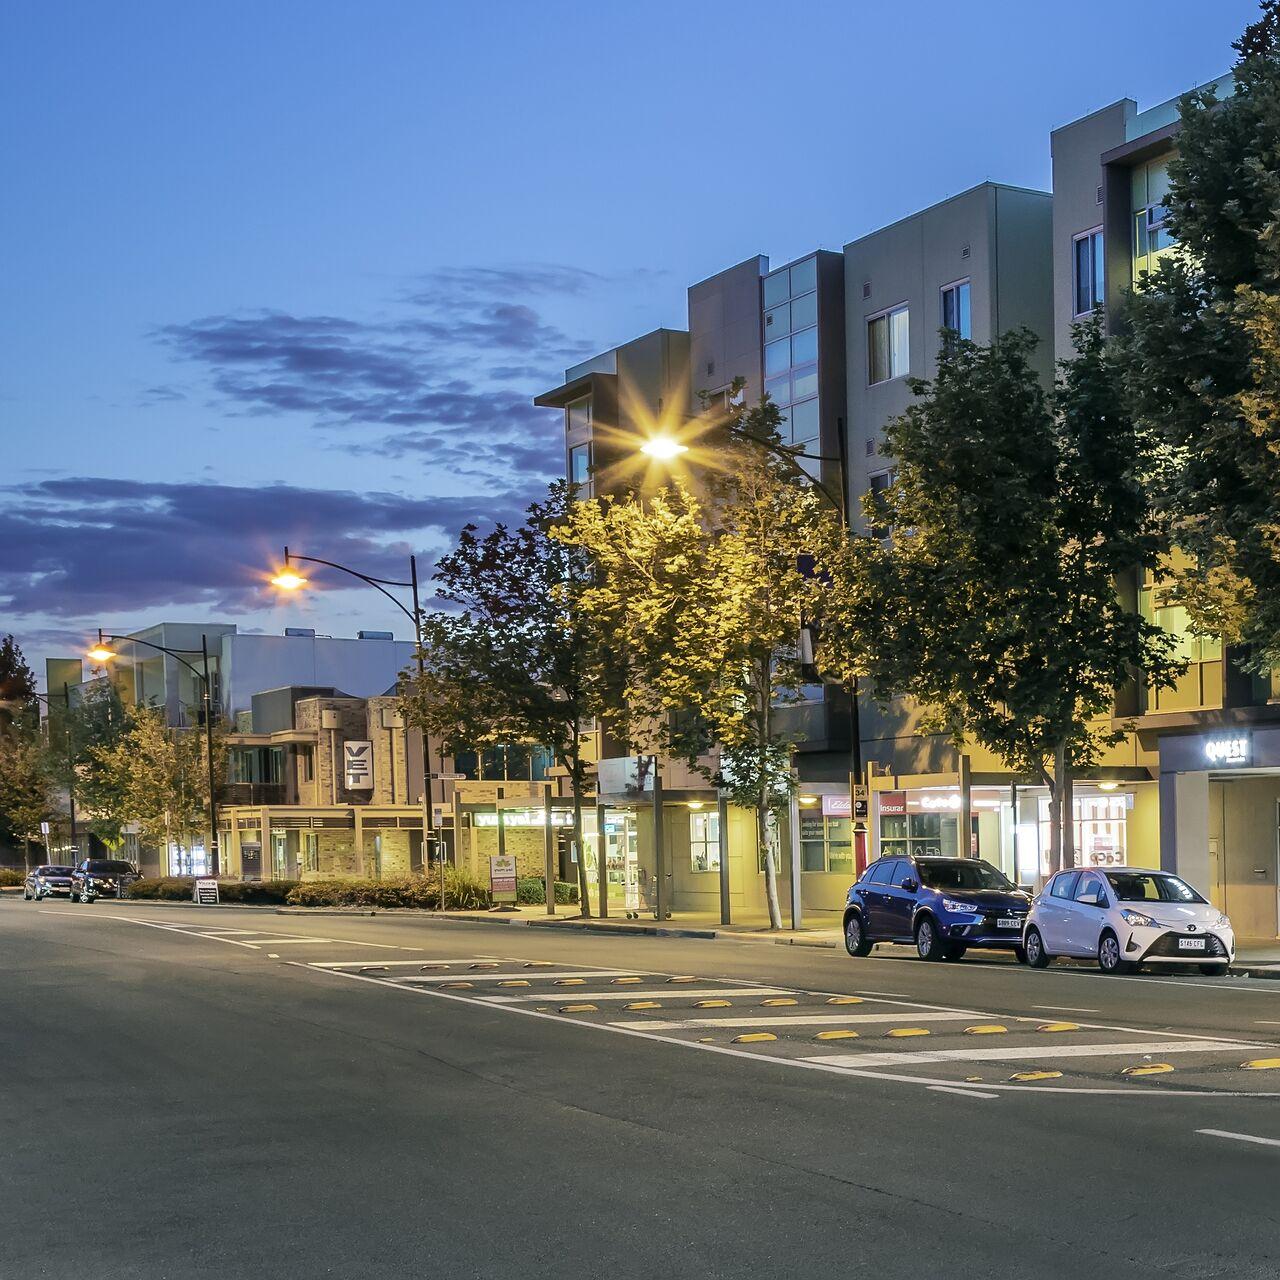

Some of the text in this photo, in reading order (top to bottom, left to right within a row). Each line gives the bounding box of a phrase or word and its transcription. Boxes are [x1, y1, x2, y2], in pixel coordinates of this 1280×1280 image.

[1205, 739, 1248, 762] QUEST
[345, 746, 370, 784] VET
[855, 789, 865, 797] 34
